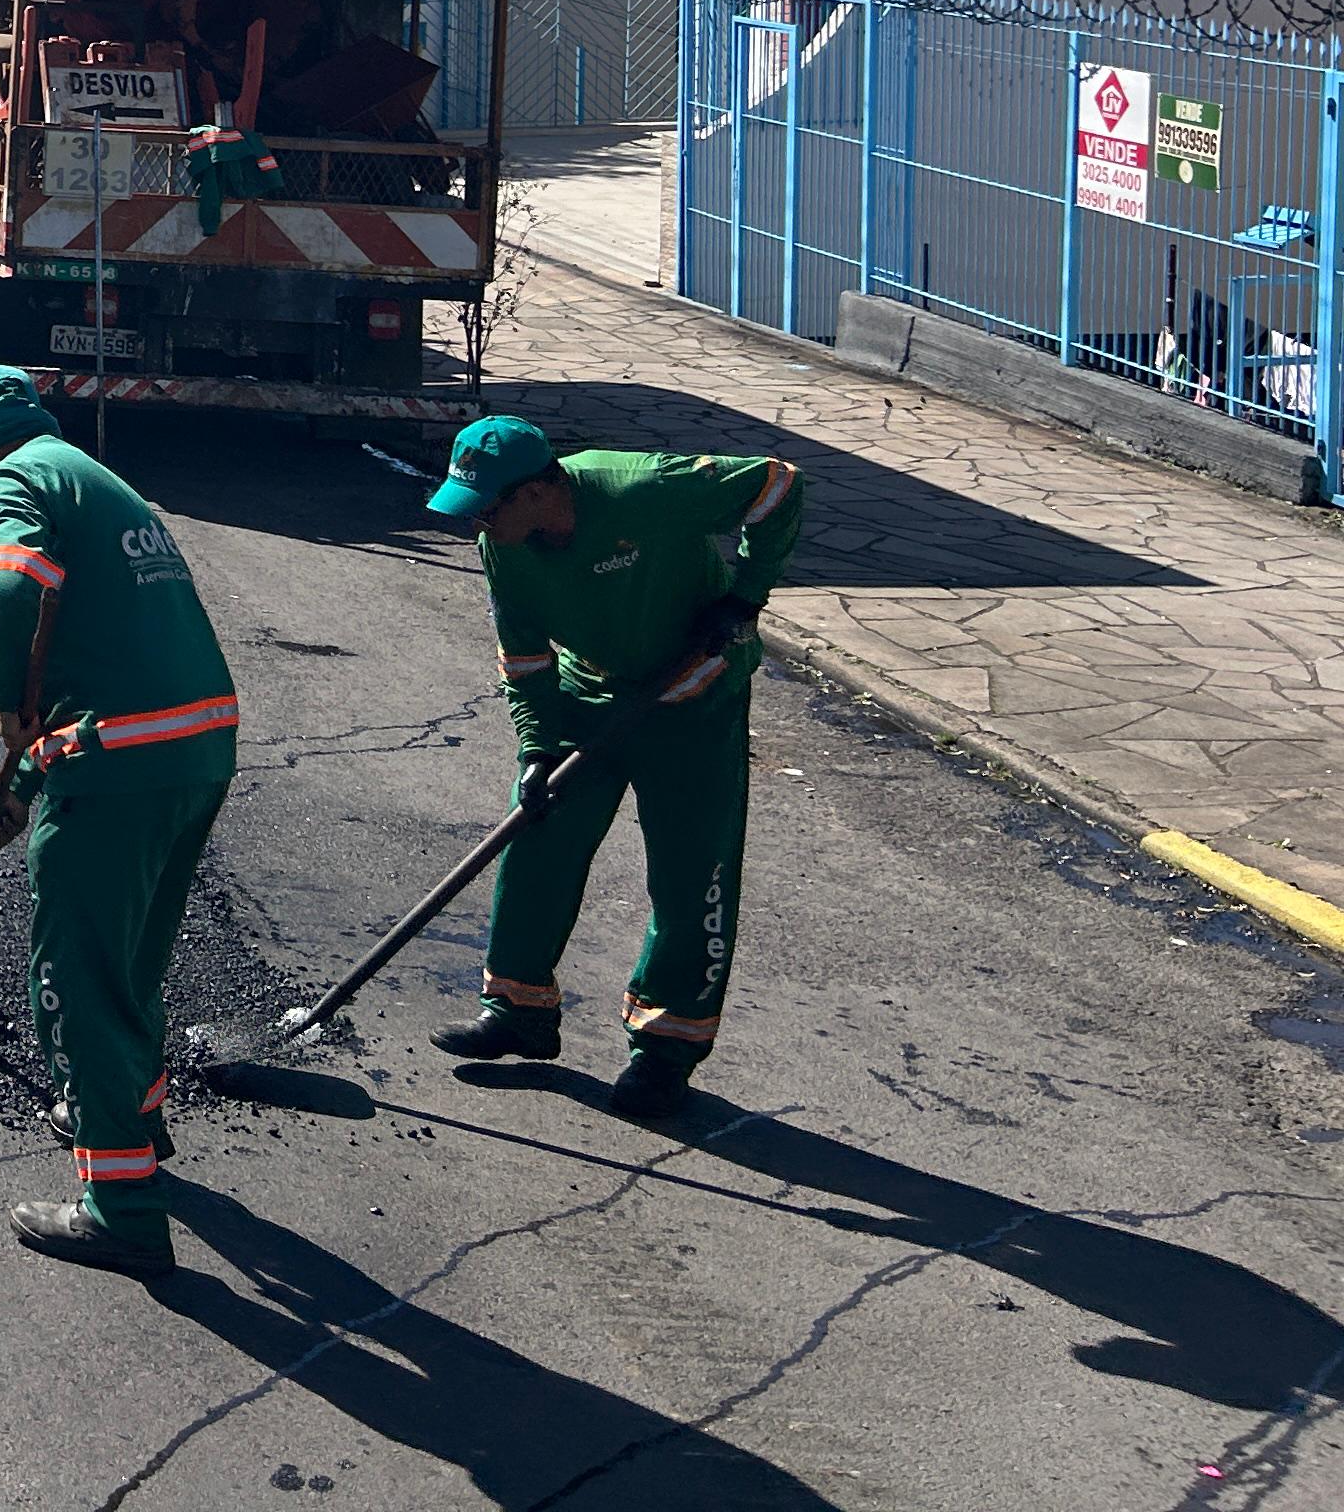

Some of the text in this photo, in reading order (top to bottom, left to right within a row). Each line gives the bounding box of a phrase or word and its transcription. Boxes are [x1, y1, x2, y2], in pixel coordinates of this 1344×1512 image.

[68, 72, 155, 98] DESVIO
[1084, 134, 1138, 167] VENDE
[1158, 121, 1218, 156] 991339596
[1082, 161, 1142, 192] 3025.4000
[1078, 186, 1145, 220] 99901.4001
[16, 262, 116, 280] KYN-658
